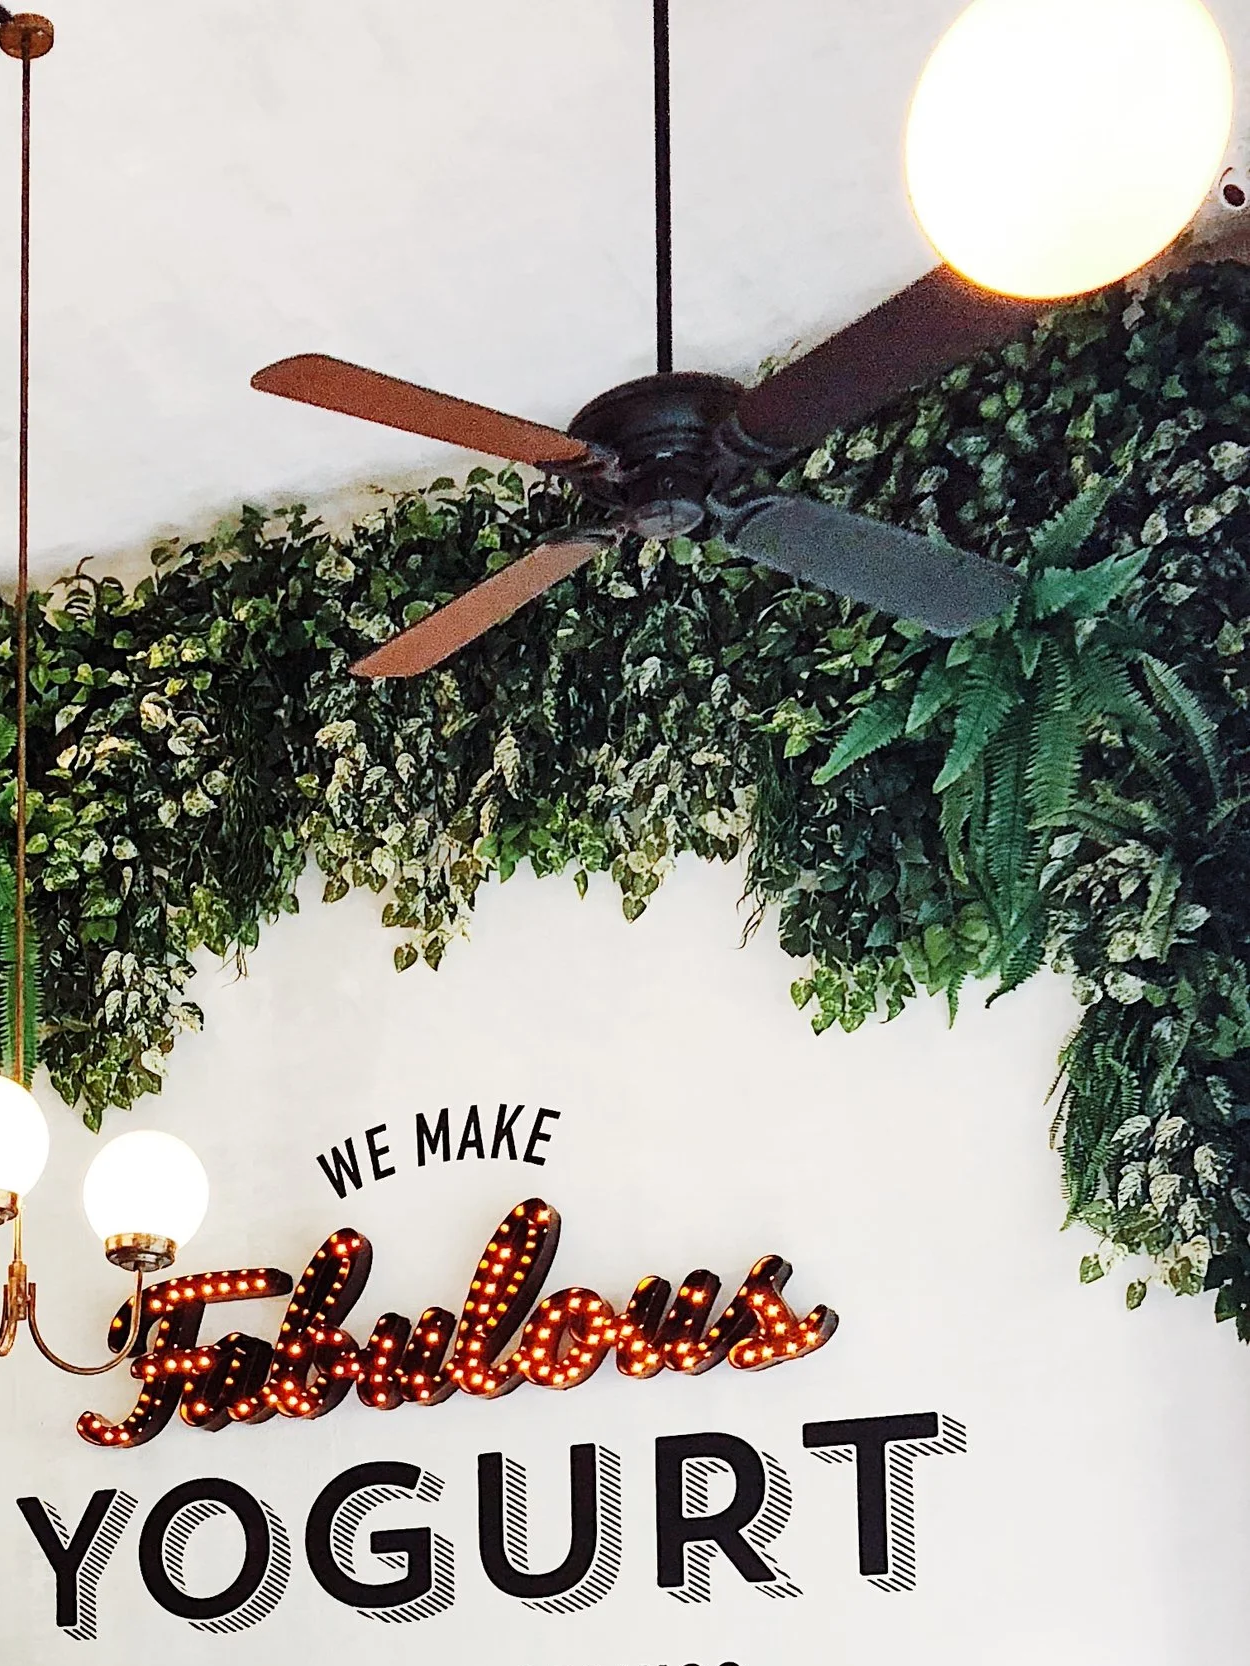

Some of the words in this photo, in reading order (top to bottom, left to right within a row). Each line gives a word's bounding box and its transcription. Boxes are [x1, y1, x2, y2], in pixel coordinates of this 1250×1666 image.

[316, 1123, 396, 1201] WE
[415, 1103, 561, 1168] MAKE
[76, 1198, 840, 1447] Fabulous
[16, 1411, 967, 1641] YOGURT
